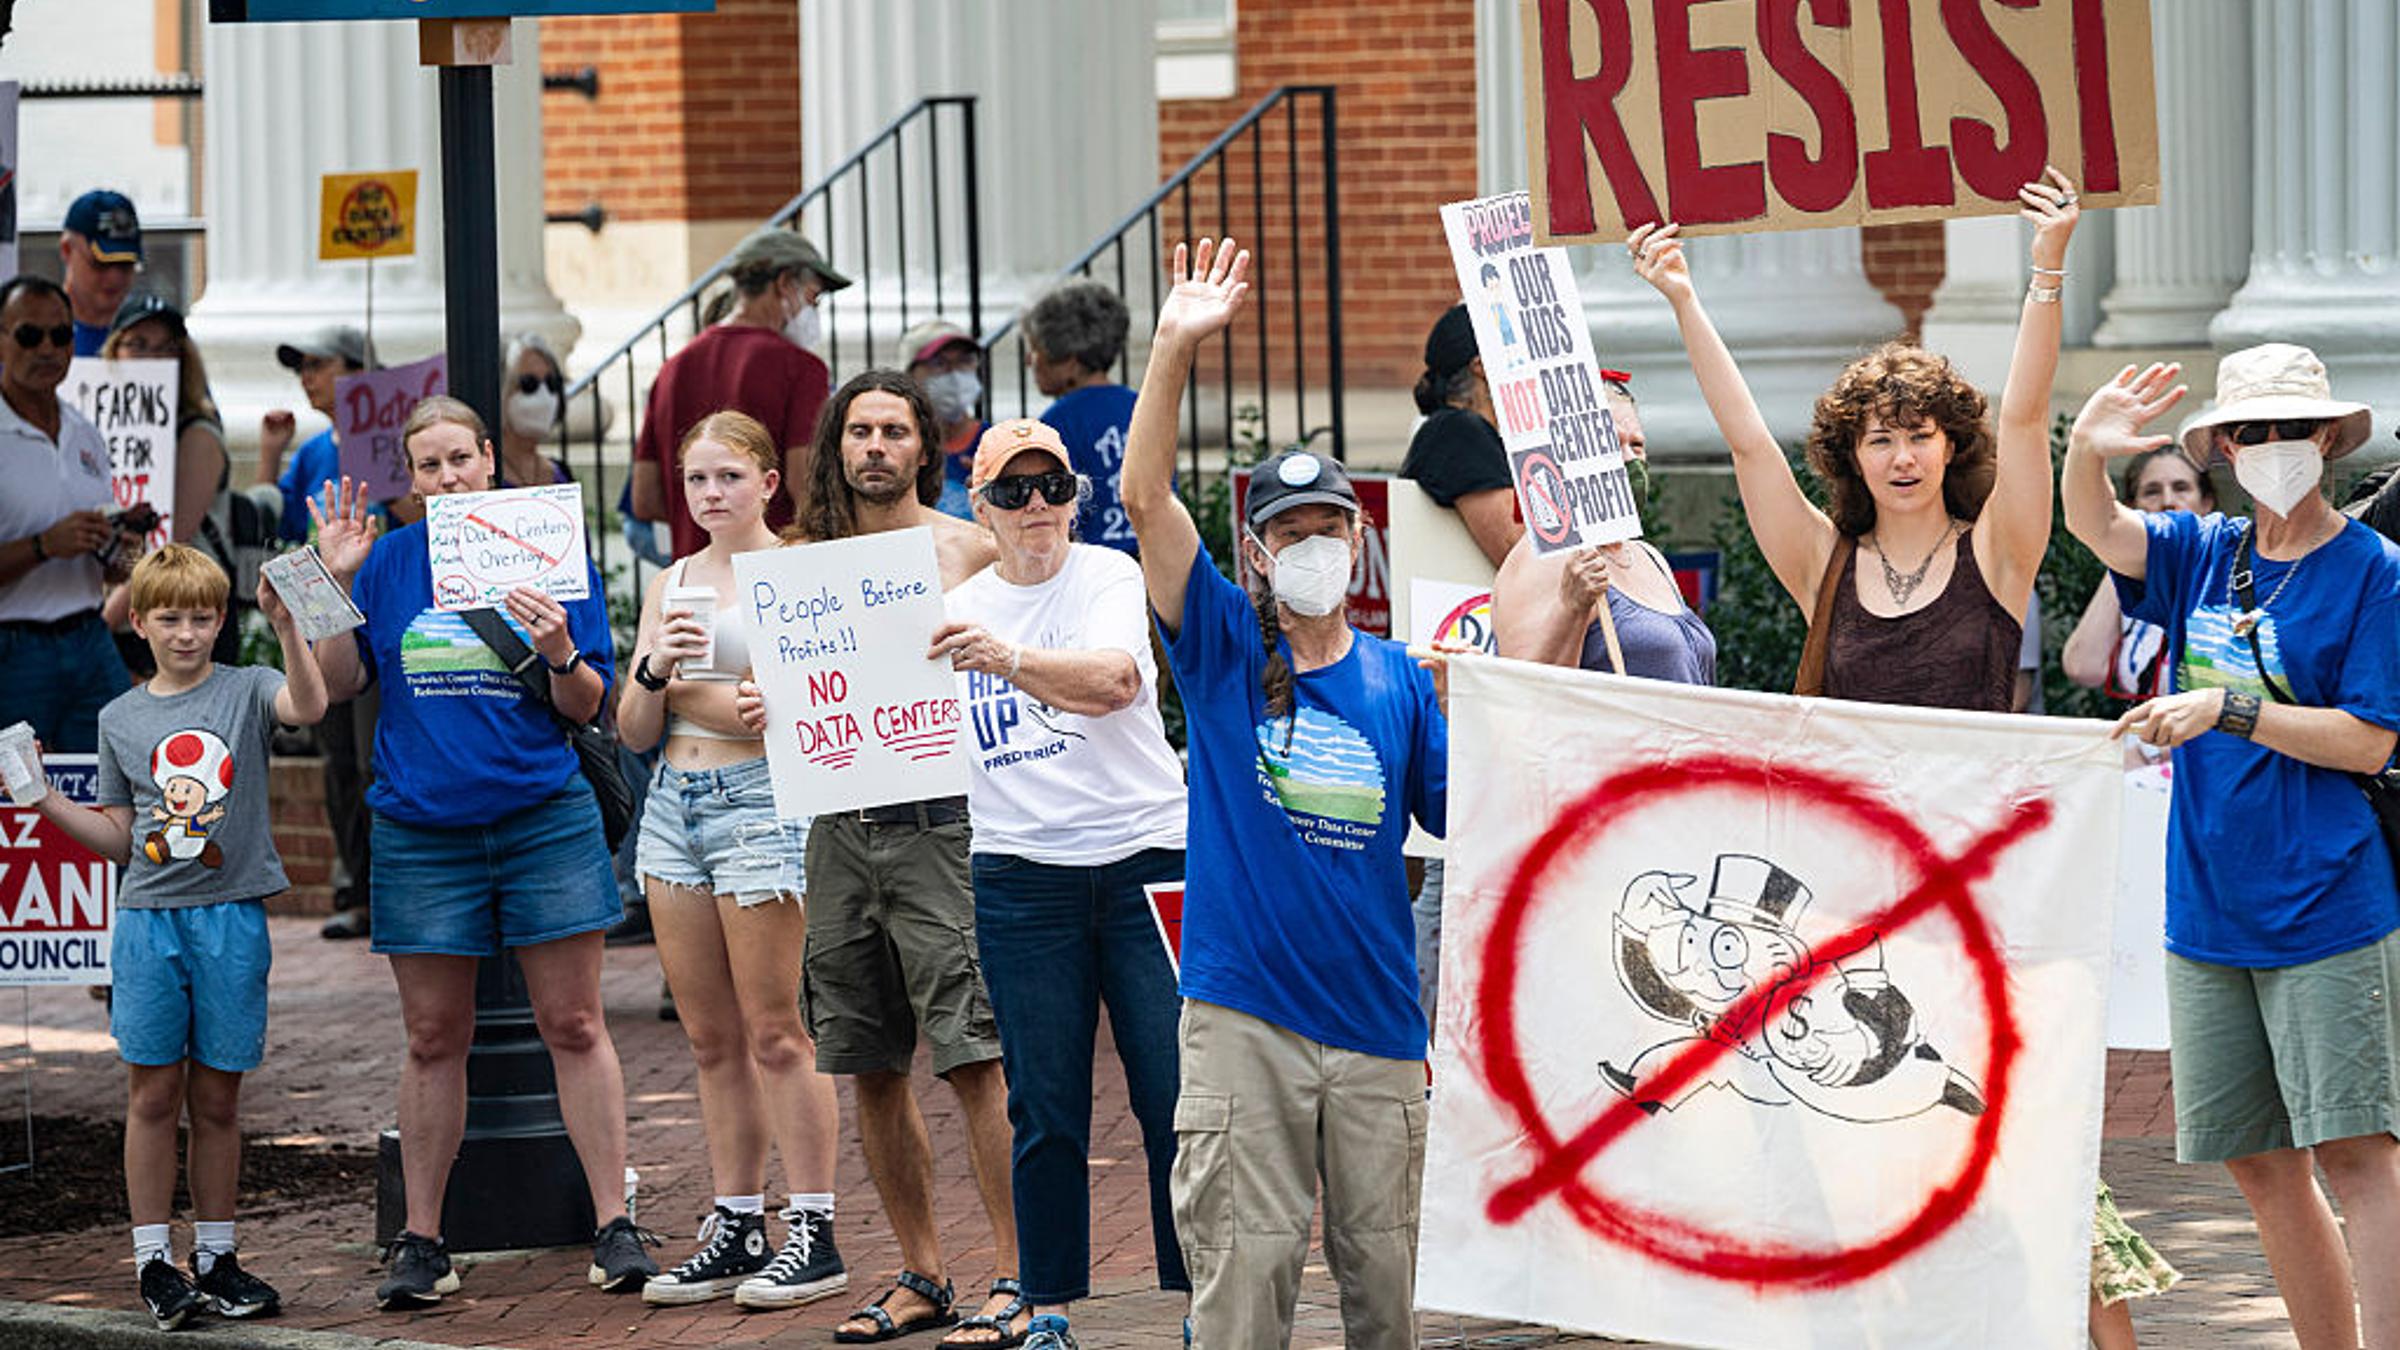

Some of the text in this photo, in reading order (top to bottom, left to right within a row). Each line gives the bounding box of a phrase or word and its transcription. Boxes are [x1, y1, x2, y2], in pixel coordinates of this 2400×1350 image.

[1540, 0, 2119, 234] RESIST
[1509, 253, 1557, 309] OUR
[1518, 303, 1574, 360] KIDS
[1499, 362, 1599, 434] NOT DATA
[123, 437, 155, 469] FOR
[1549, 408, 1620, 464] CENTER
[1563, 467, 1634, 528] PROFIT
[514, 515, 571, 540] Centers
[479, 549, 546, 571] Overlay
[753, 578, 928, 633] People Before
[778, 626, 858, 663] Profits!!
[807, 670, 848, 708] NO
[968, 668, 1021, 700] RIS
[795, 698, 963, 755] DATA CENTERS
[970, 697, 1020, 752] UP
[984, 739, 1068, 773] FREDERICK
[86, 773, 98, 797] 4
